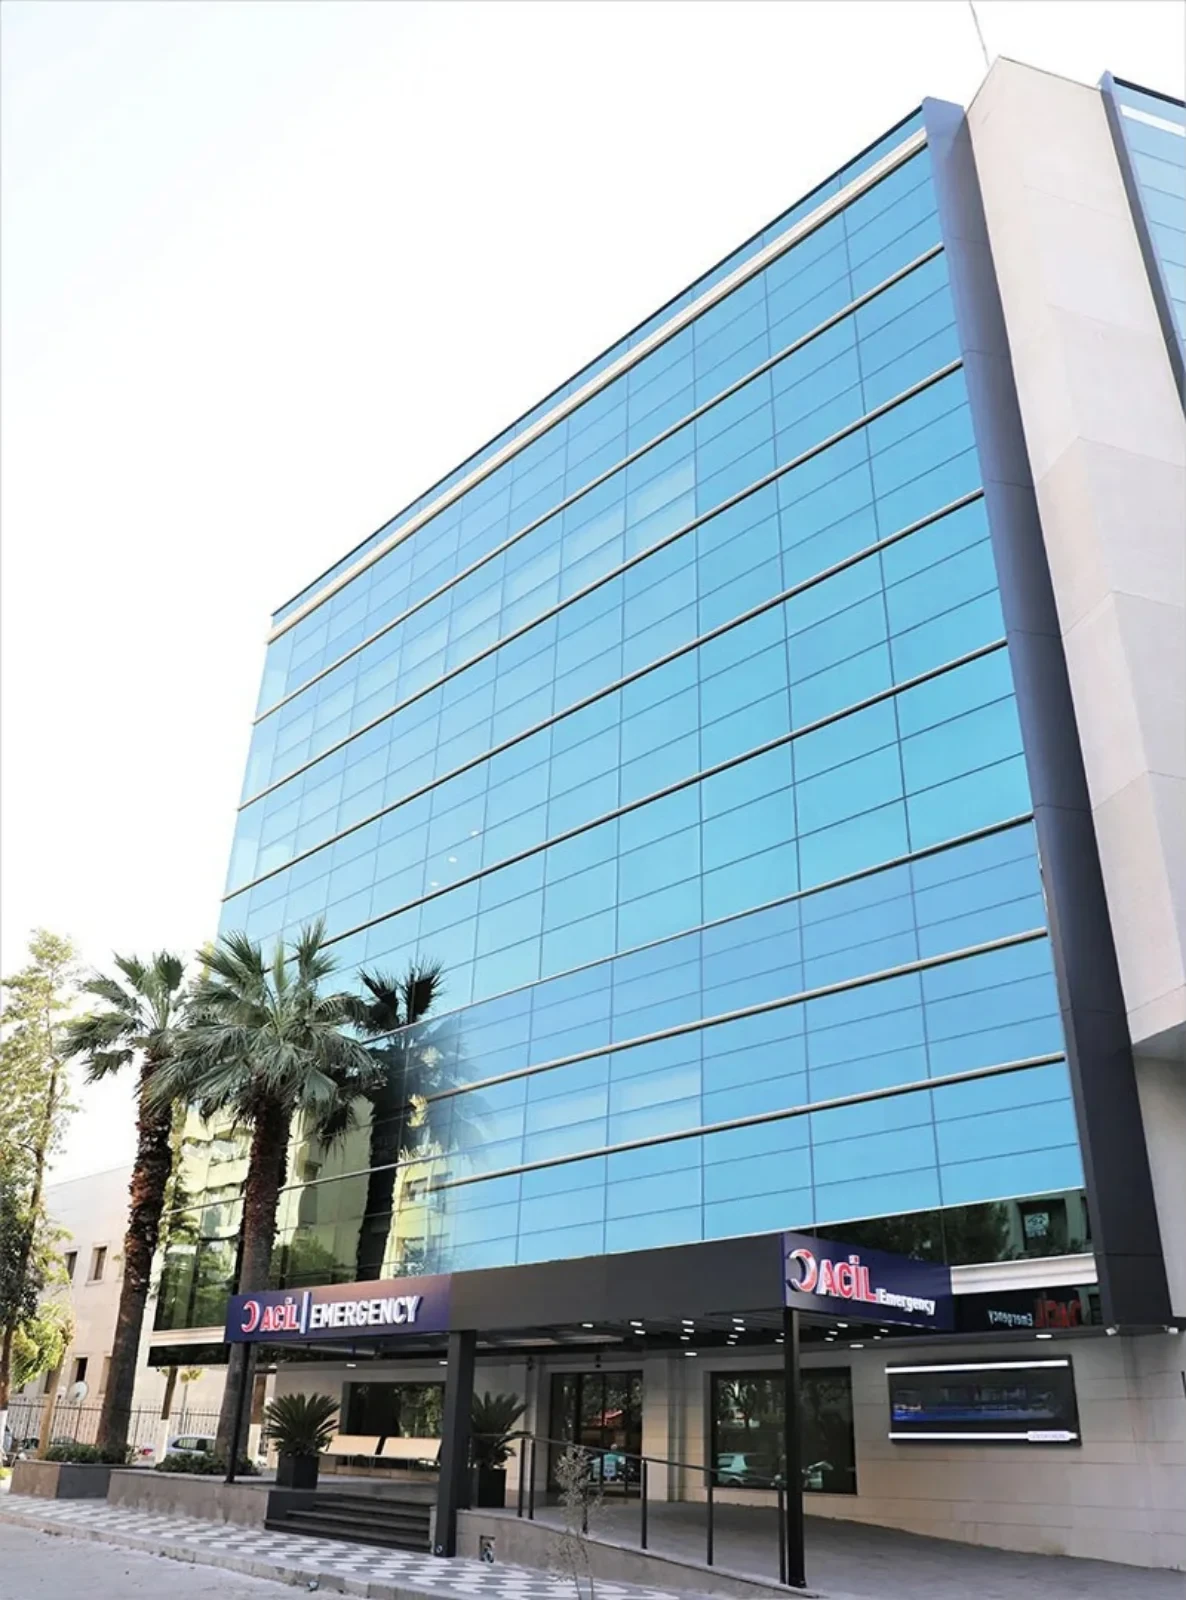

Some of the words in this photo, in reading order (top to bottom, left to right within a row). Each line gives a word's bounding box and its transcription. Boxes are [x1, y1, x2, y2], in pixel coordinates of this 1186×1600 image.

[817, 1255, 876, 1302] ACİL
[877, 1288, 936, 1316] Emergency
[260, 1297, 299, 1331] ACİL
[309, 1297, 421, 1329] EMERGENCY
